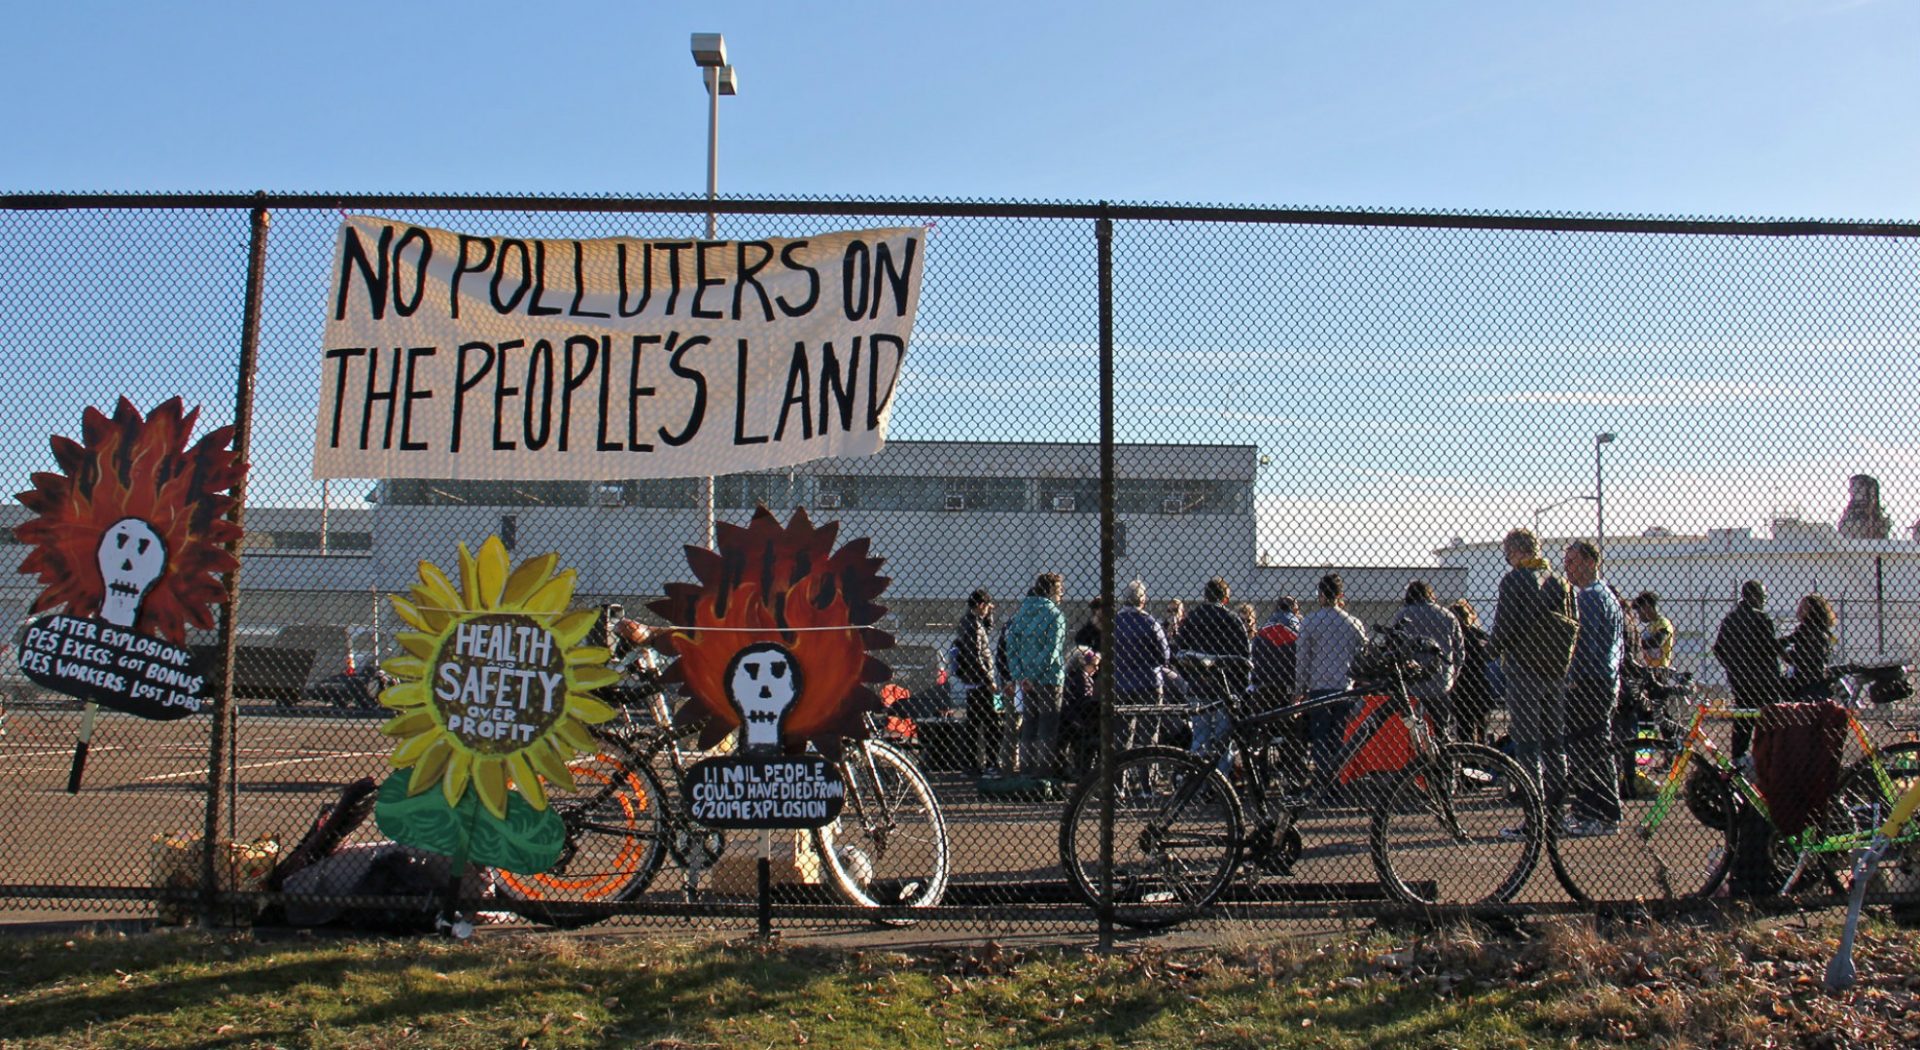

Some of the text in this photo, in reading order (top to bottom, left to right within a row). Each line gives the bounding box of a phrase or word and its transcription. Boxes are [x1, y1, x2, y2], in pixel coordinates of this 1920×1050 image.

[336, 225, 917, 322] NO POLLUTERS ON
[326, 331, 905, 453] THE PEOPLE'S LAND
[47, 616, 191, 667] AFTER EXPLOSION:
[61, 638, 113, 665] EXECS:
[118, 655, 146, 672] GOT
[456, 623, 552, 667] HEALTH
[56, 659, 126, 693] WORKERS:
[130, 680, 164, 701] LOST
[163, 691, 201, 712] JOBS
[435, 662, 563, 713] SAFETY
[448, 715, 535, 743] PROFIT
[467, 706, 517, 722] OVER
[692, 781, 844, 801] COULD HAVE DIED FROM
[723, 765, 761, 784] MIL
[764, 762, 825, 783] PEOPLE
[691, 800, 827, 820] 6/2019 EXPLOSION
